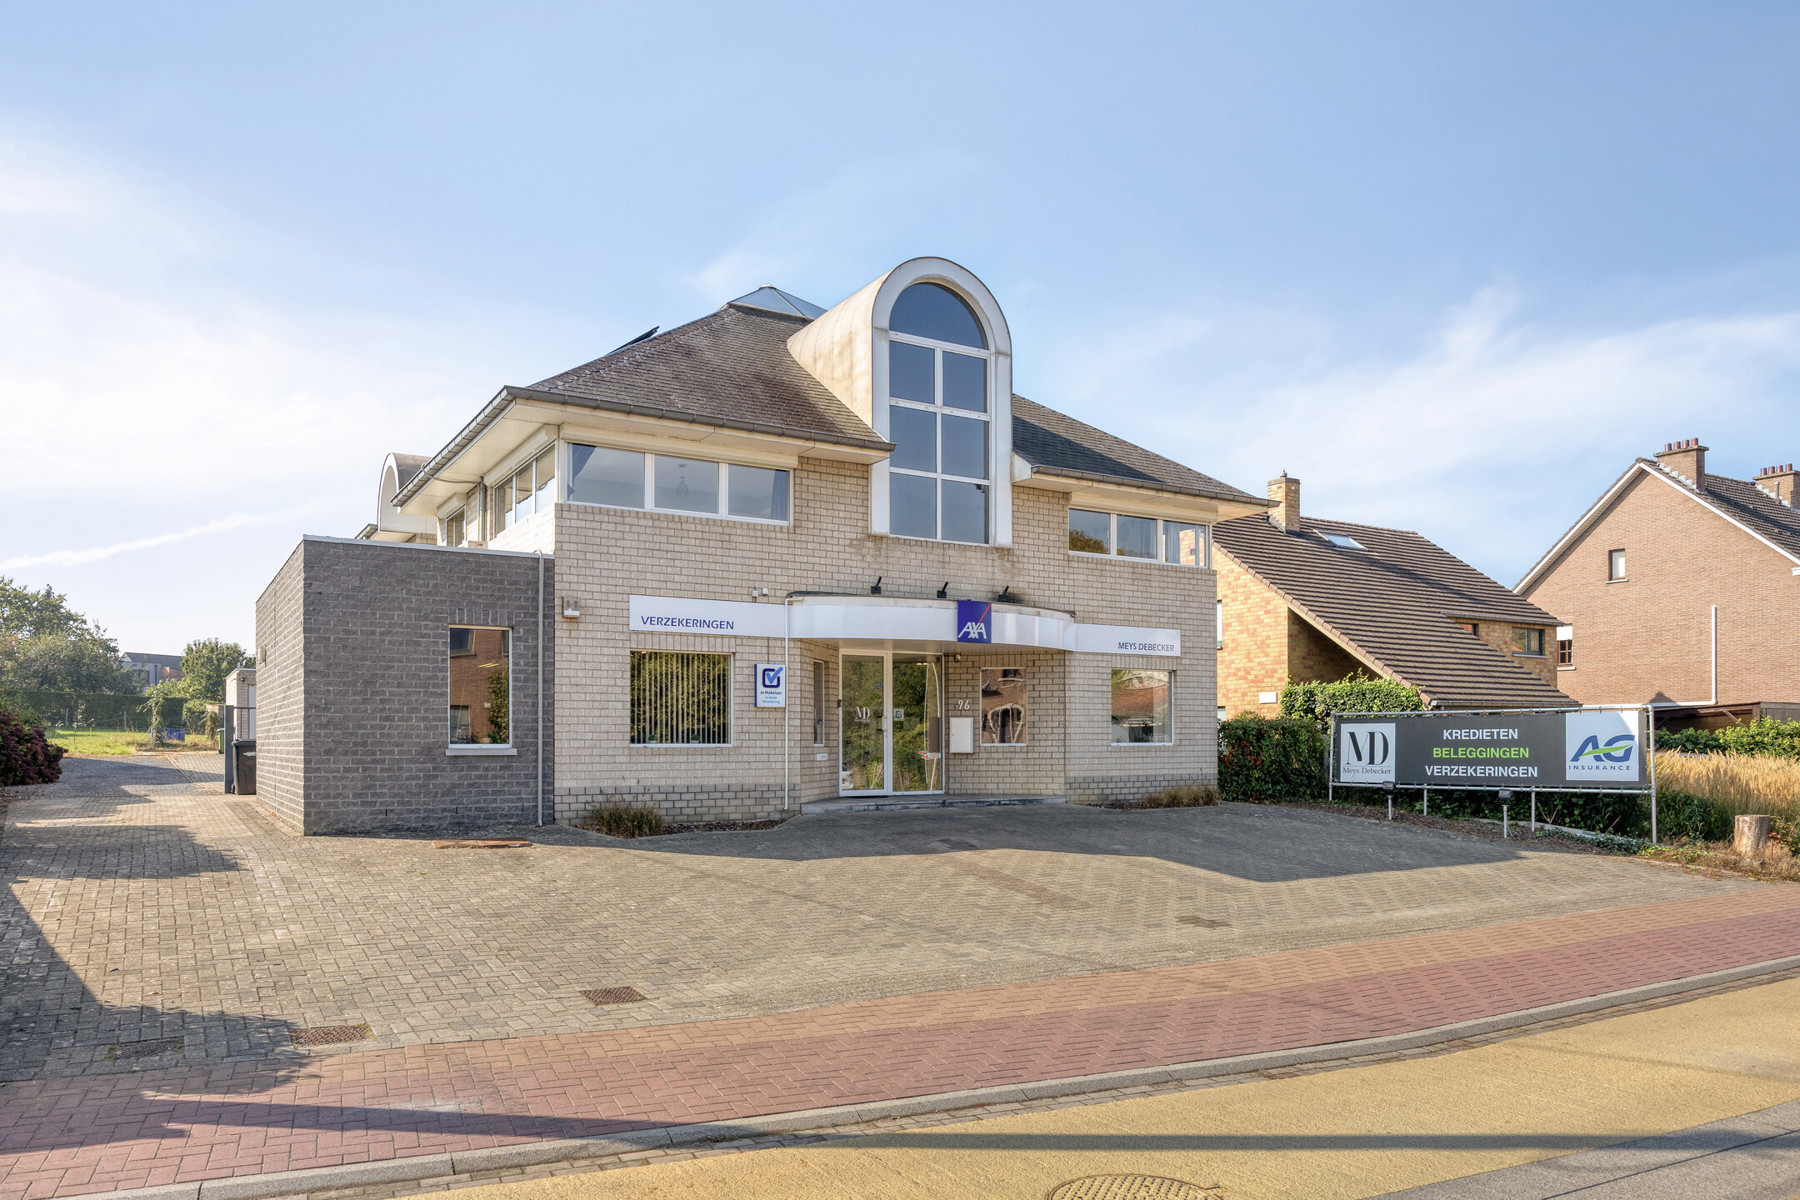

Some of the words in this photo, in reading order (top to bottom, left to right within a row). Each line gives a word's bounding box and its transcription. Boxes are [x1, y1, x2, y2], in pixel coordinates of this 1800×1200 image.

[641, 615, 734, 630] VERZEKERINGEN
[958, 621, 988, 640] AXA
[1118, 641, 1137, 650] MEYS
[1138, 643, 1175, 652] DEBECKER
[957, 699, 970, 710] 96
[1443, 728, 1519, 740] KREDIETEN
[1433, 747, 1529, 758] BELEGGINGEN
[1570, 734, 1635, 763] AG
[1342, 767, 1360, 777] Meys
[1361, 767, 1392, 775] Debecker
[1425, 765, 1538, 777] VERZEKERINGEN
